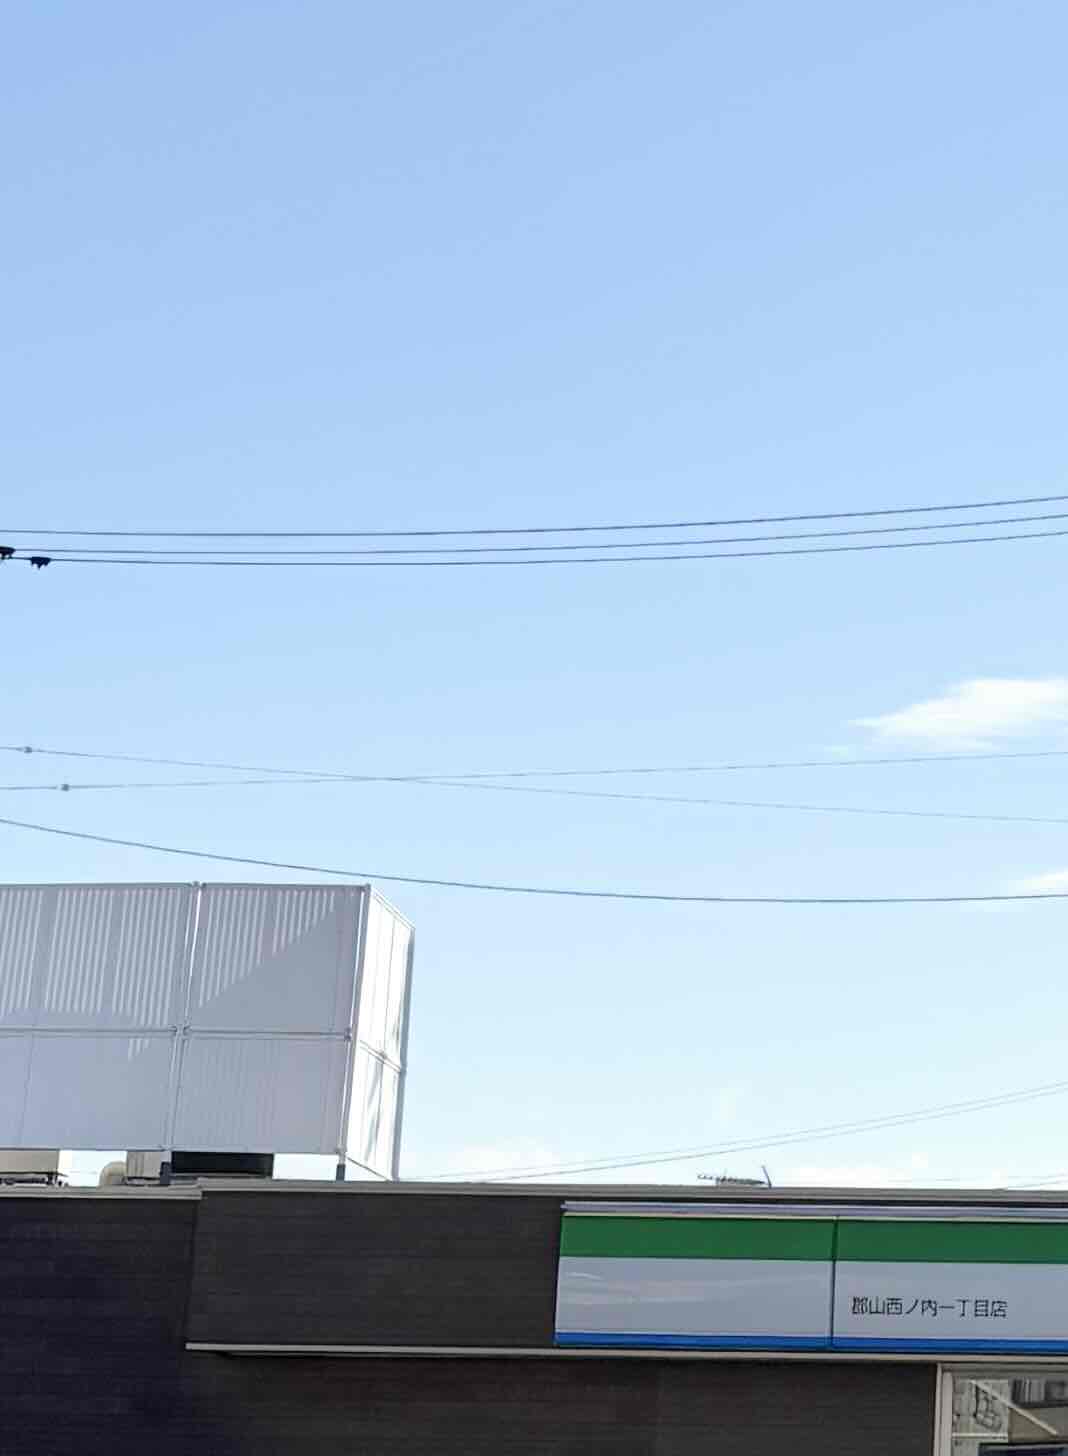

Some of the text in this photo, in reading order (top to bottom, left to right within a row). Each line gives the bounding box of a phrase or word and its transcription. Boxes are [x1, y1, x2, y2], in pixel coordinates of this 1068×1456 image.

[851, 1296, 1008, 1318] 郡山西ノ内一丁目店
